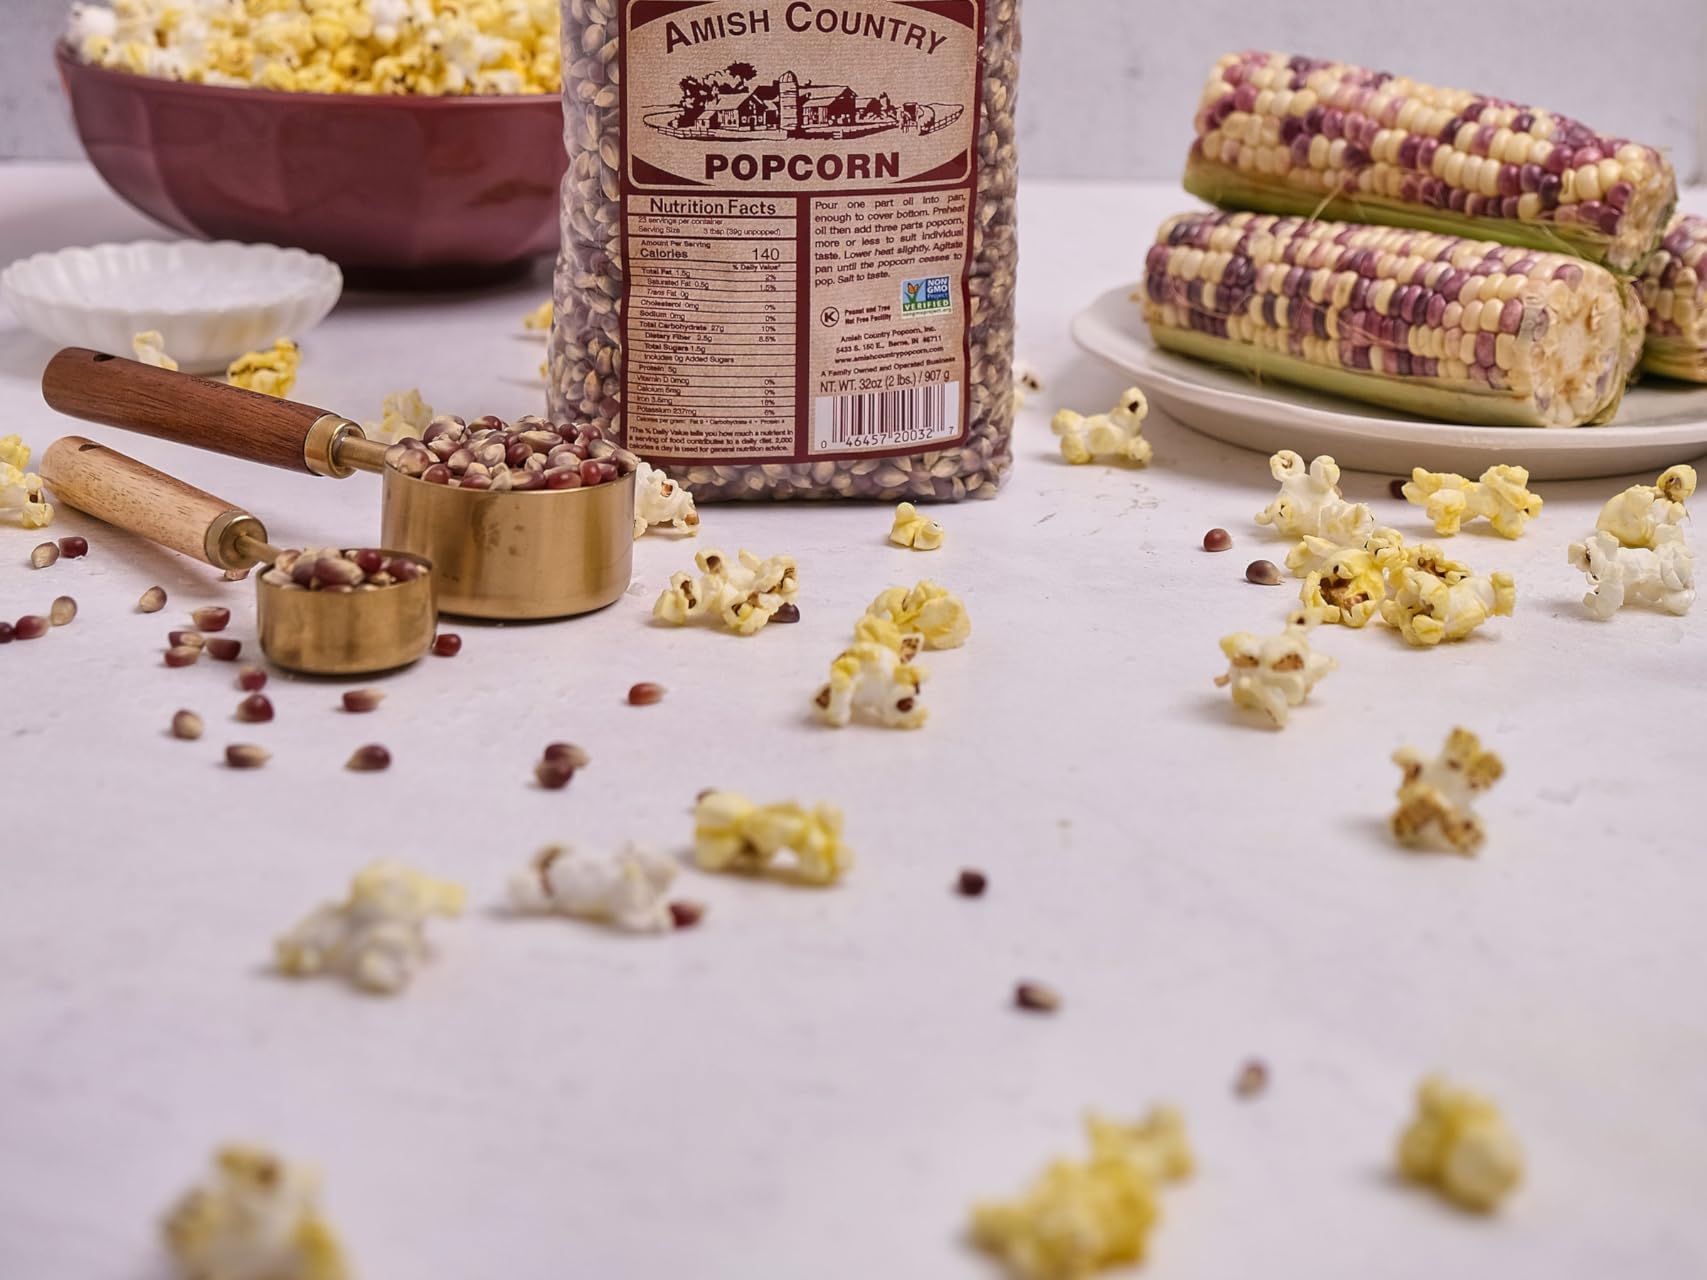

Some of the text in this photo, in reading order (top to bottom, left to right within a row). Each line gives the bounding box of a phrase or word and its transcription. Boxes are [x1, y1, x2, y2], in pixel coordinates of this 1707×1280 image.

[706, 152, 900, 181] POPCORN
[651, 198, 776, 214] Nutrition Facts
[815, 201, 838, 209] Pour
[875, 199, 893, 209] part
[903, 197, 913, 205] oil
[923, 196, 939, 204] into
[948, 194, 966, 203] pan,
[815, 214, 851, 223] enough
[868, 212, 893, 220] cover
[897, 210, 929, 218] bottom.
[639, 226, 665, 234] Serving
[815, 226, 826, 235] oil
[830, 225, 850, 234] then
[855, 224, 871, 233] add
[875, 223, 897, 232] three
[901, 222, 923, 232] parts
[815, 228, 964, 248] more or less to suit individual
[640, 248, 780, 261] Calories 140
[815, 241, 963, 260] taste. Lower heat slightly. Agitate
[815, 265, 833, 274] pan
[837, 263, 857, 271] until
[861, 261, 874, 269] the
[878, 257, 915, 267] popcorn
[919, 254, 949, 263] ceases
[815, 271, 890, 287] pop. Salt to taste.
[928, 278, 947, 286] NON
[927, 285, 947, 293] GMO
[905, 300, 949, 311] VERIFIED
[640, 310, 666, 318] Sodium
[864, 331, 890, 340] Country
[821, 381, 837, 392] NT.
[839, 381, 857, 391] WT.
[859, 378, 882, 390] 32oz
[885, 376, 894, 390] (2
[897, 373, 916, 388] lbs.)
[925, 370, 941, 382] 907
[821, 426, 954, 448] 0 46457 20032 7
